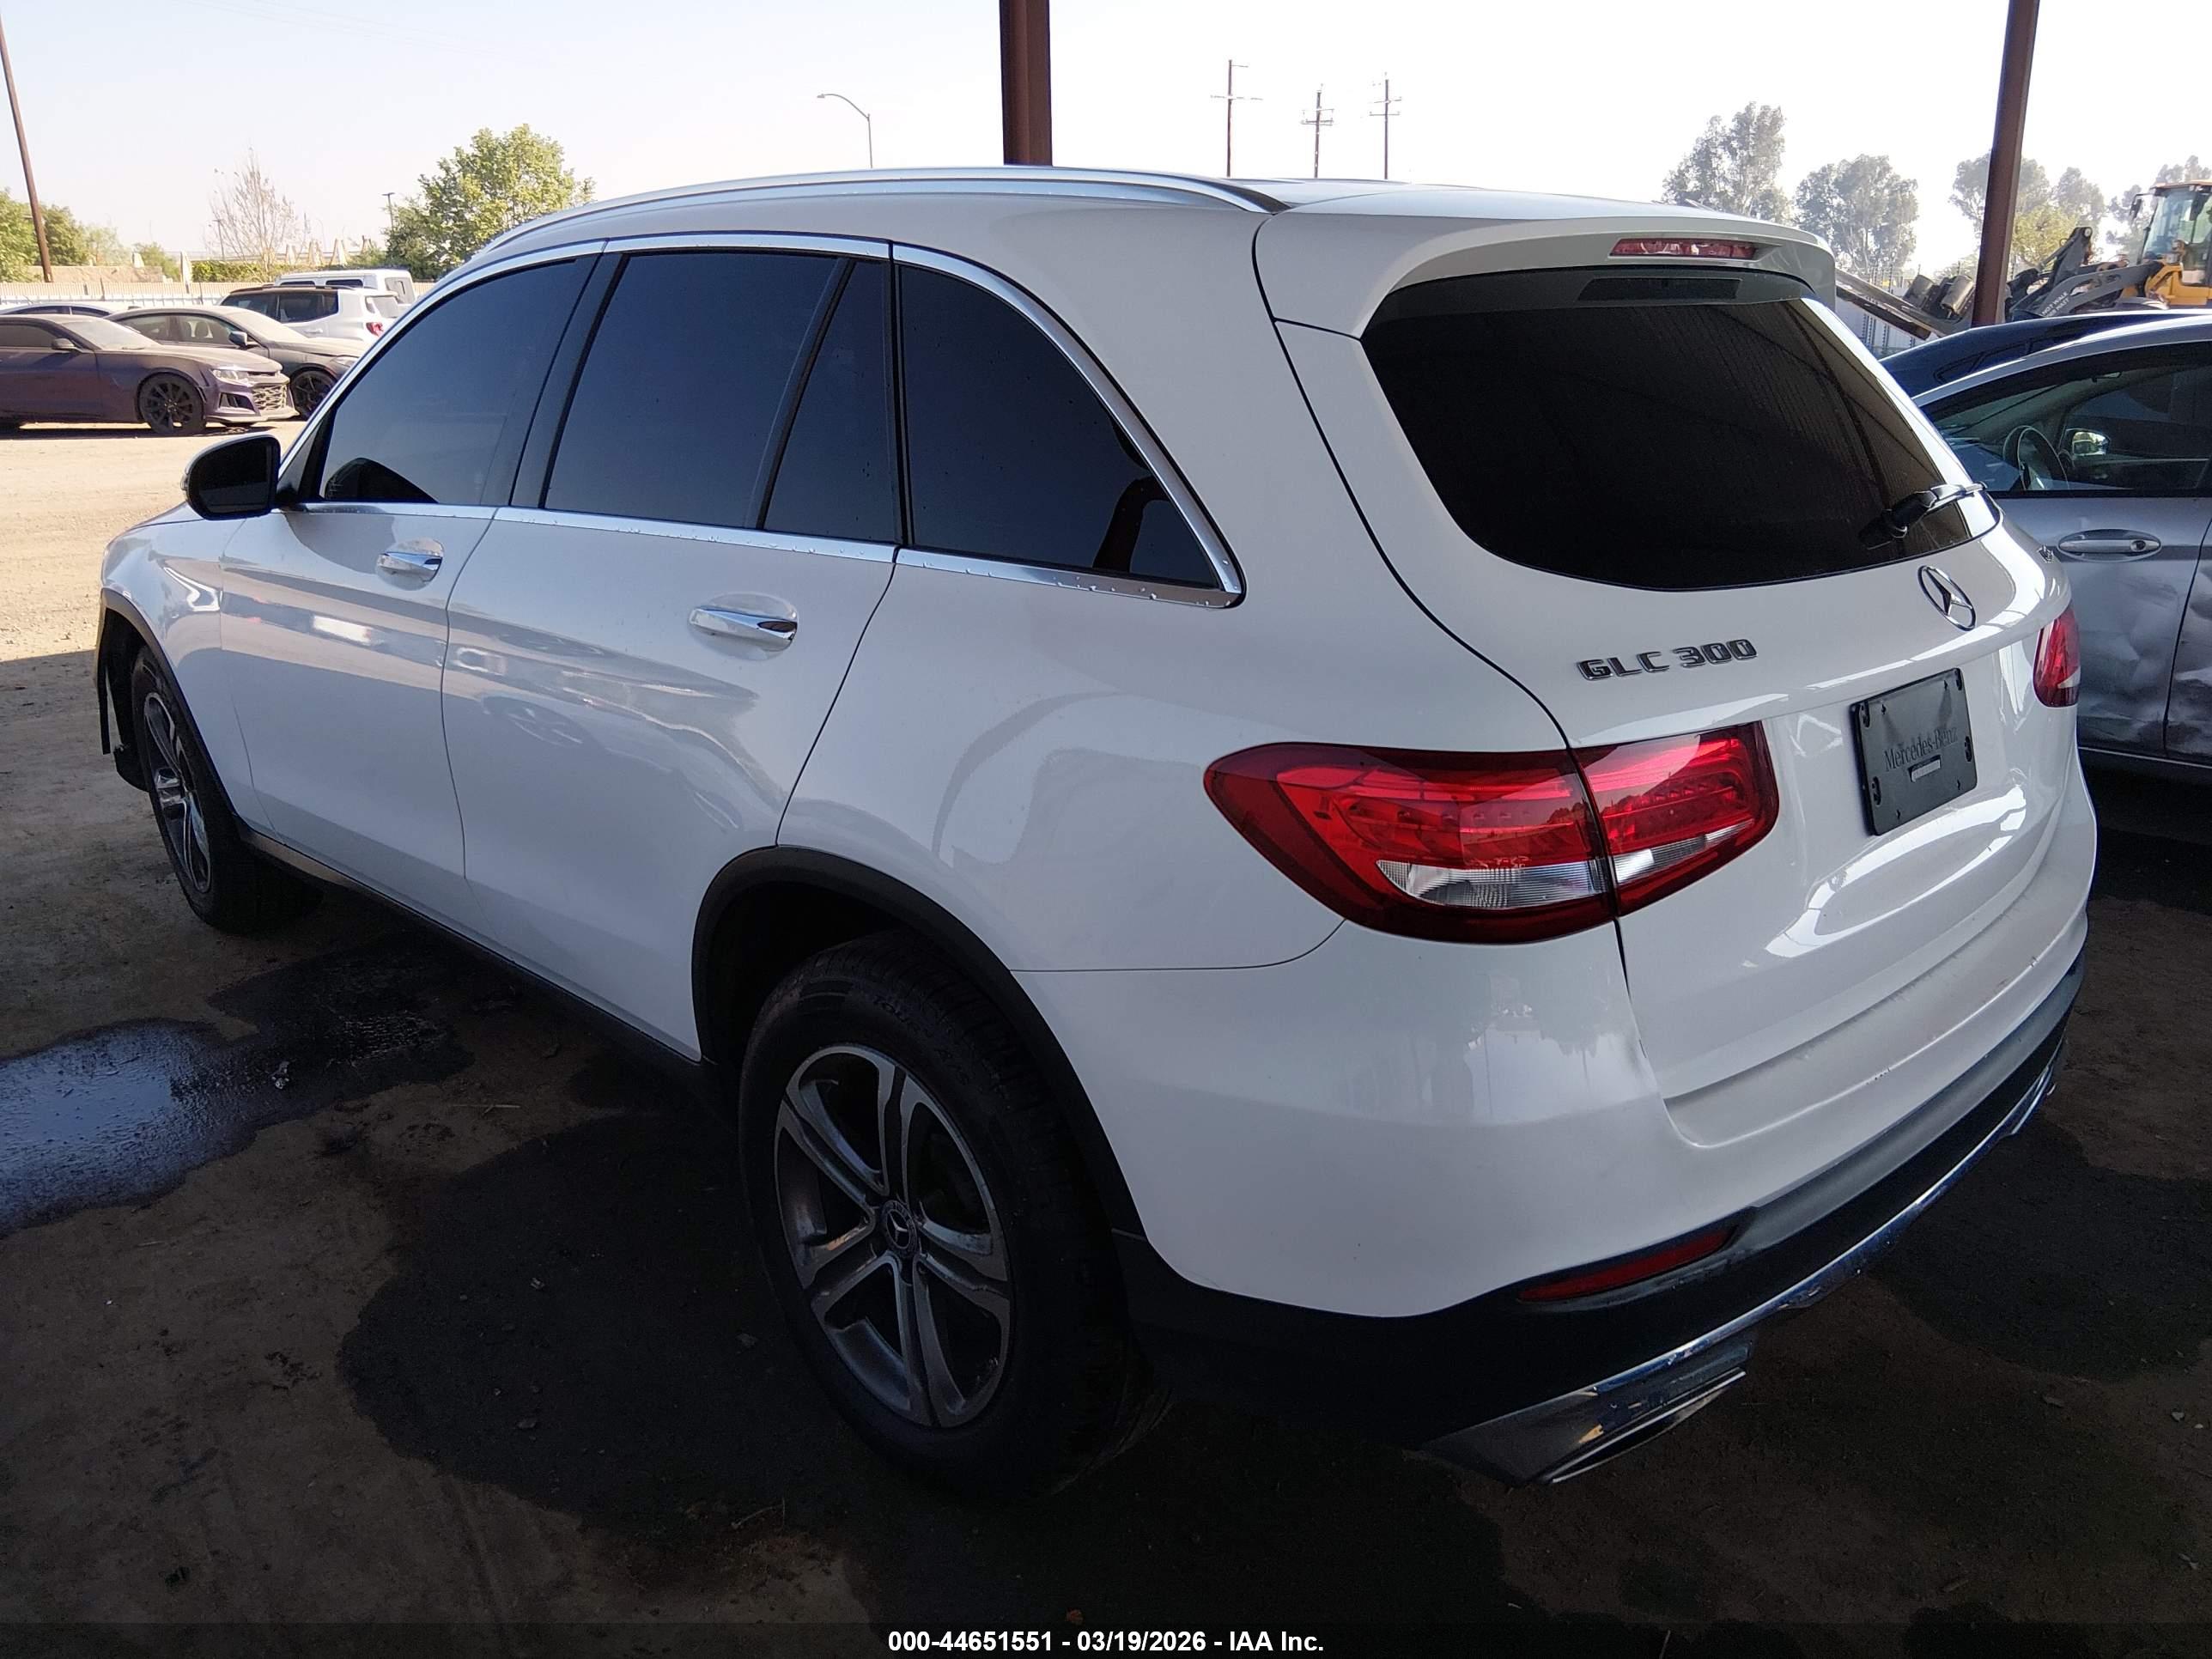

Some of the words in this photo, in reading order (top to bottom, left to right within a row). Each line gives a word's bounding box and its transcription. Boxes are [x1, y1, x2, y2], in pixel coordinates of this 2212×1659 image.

[1576, 651, 1670, 681] GLC
[1672, 639, 1758, 668] 300
[1884, 727, 1958, 772] Mercedes-Benz
